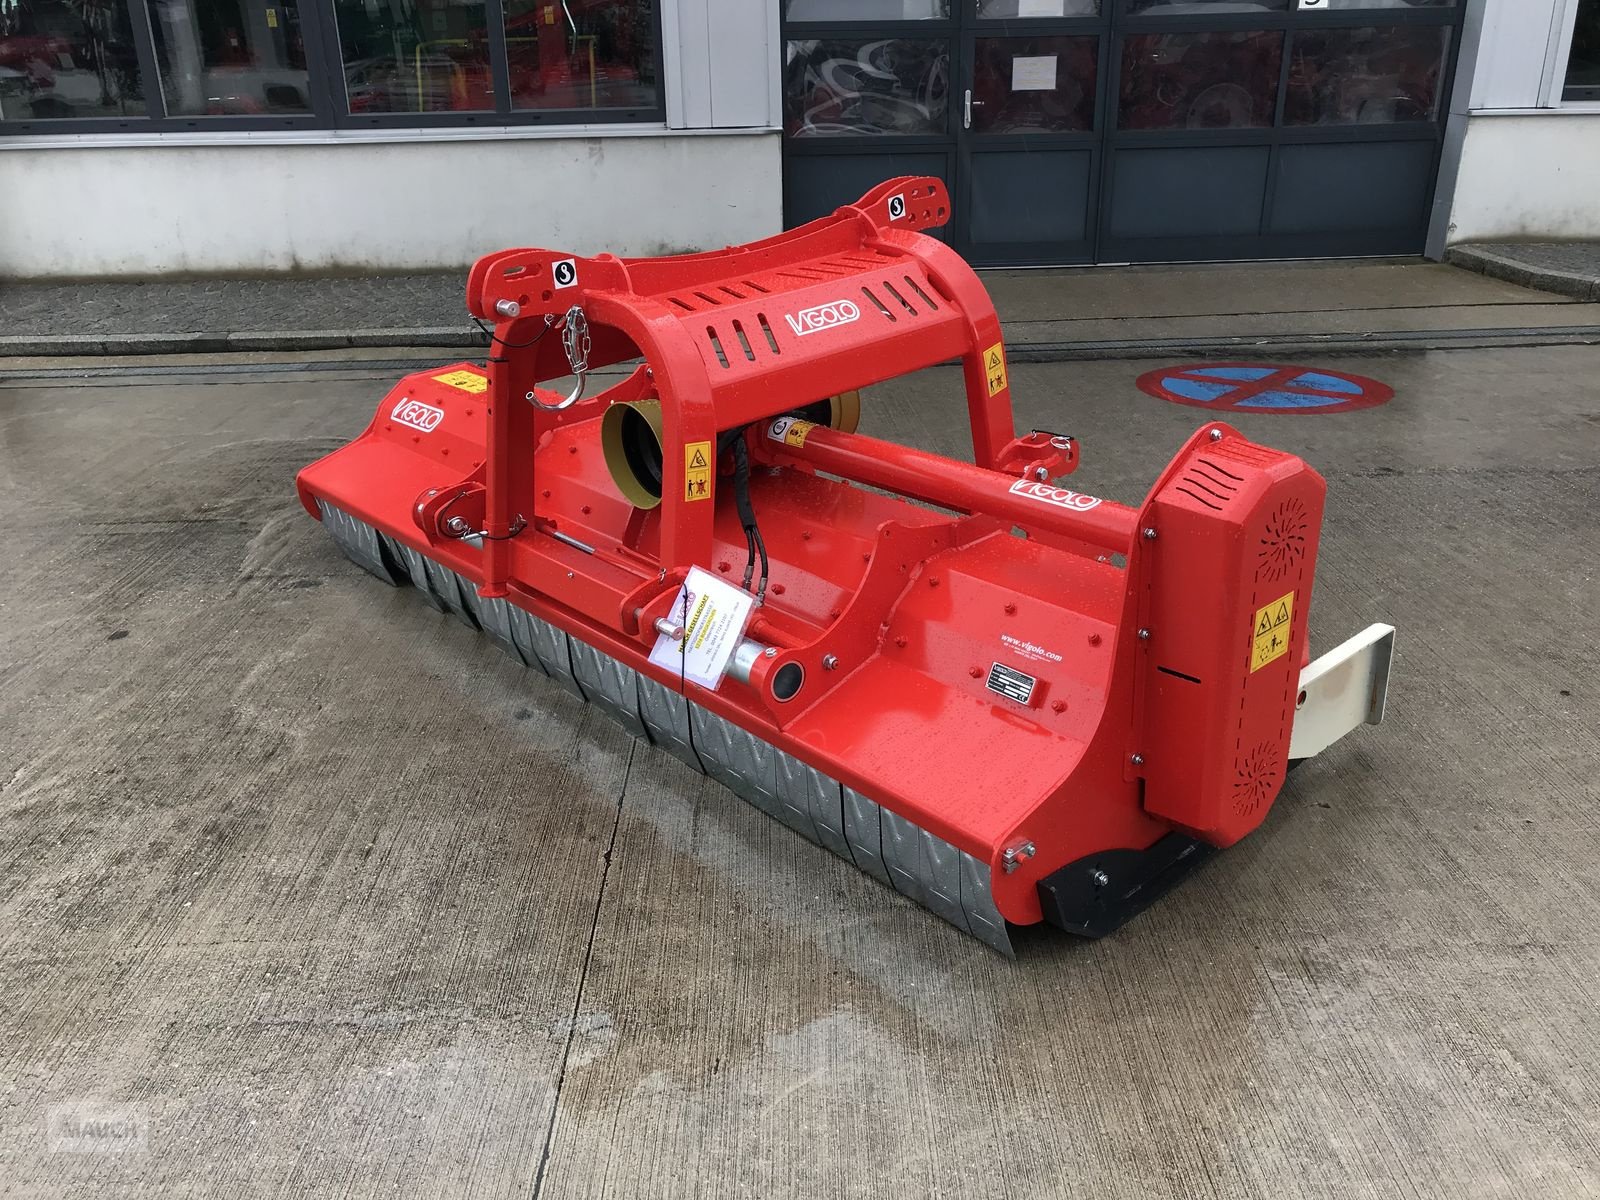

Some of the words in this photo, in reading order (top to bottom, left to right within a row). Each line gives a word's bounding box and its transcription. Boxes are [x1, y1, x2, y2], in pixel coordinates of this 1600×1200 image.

[785, 300, 860, 336] VIGOLO
[391, 398, 444, 432] VIGOLO
[1009, 479, 1101, 510] VIGOLO
[1000, 634, 1063, 662] www.vigolo.com
